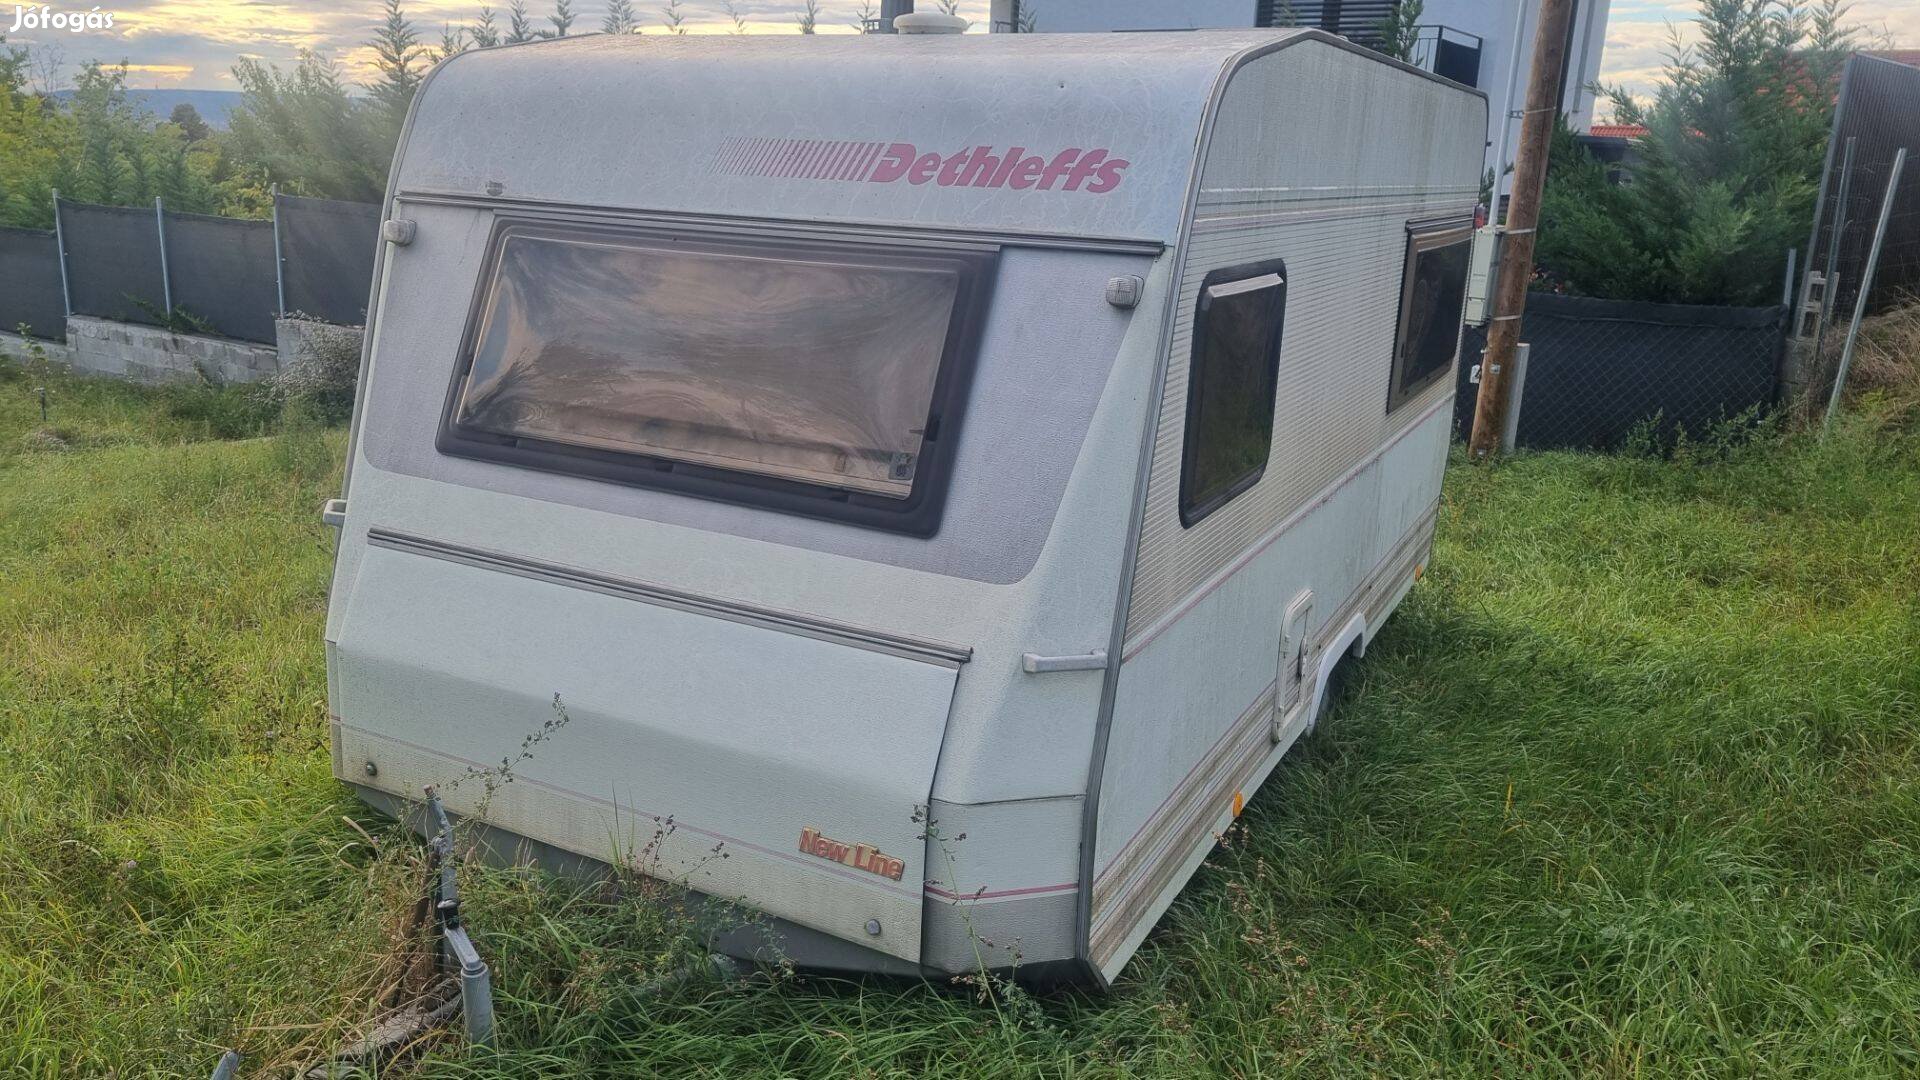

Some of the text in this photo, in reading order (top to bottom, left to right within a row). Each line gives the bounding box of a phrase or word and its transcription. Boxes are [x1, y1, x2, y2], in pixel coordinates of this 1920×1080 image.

[869, 143, 1130, 193] Dethleffs
[800, 827, 904, 880] New Line
